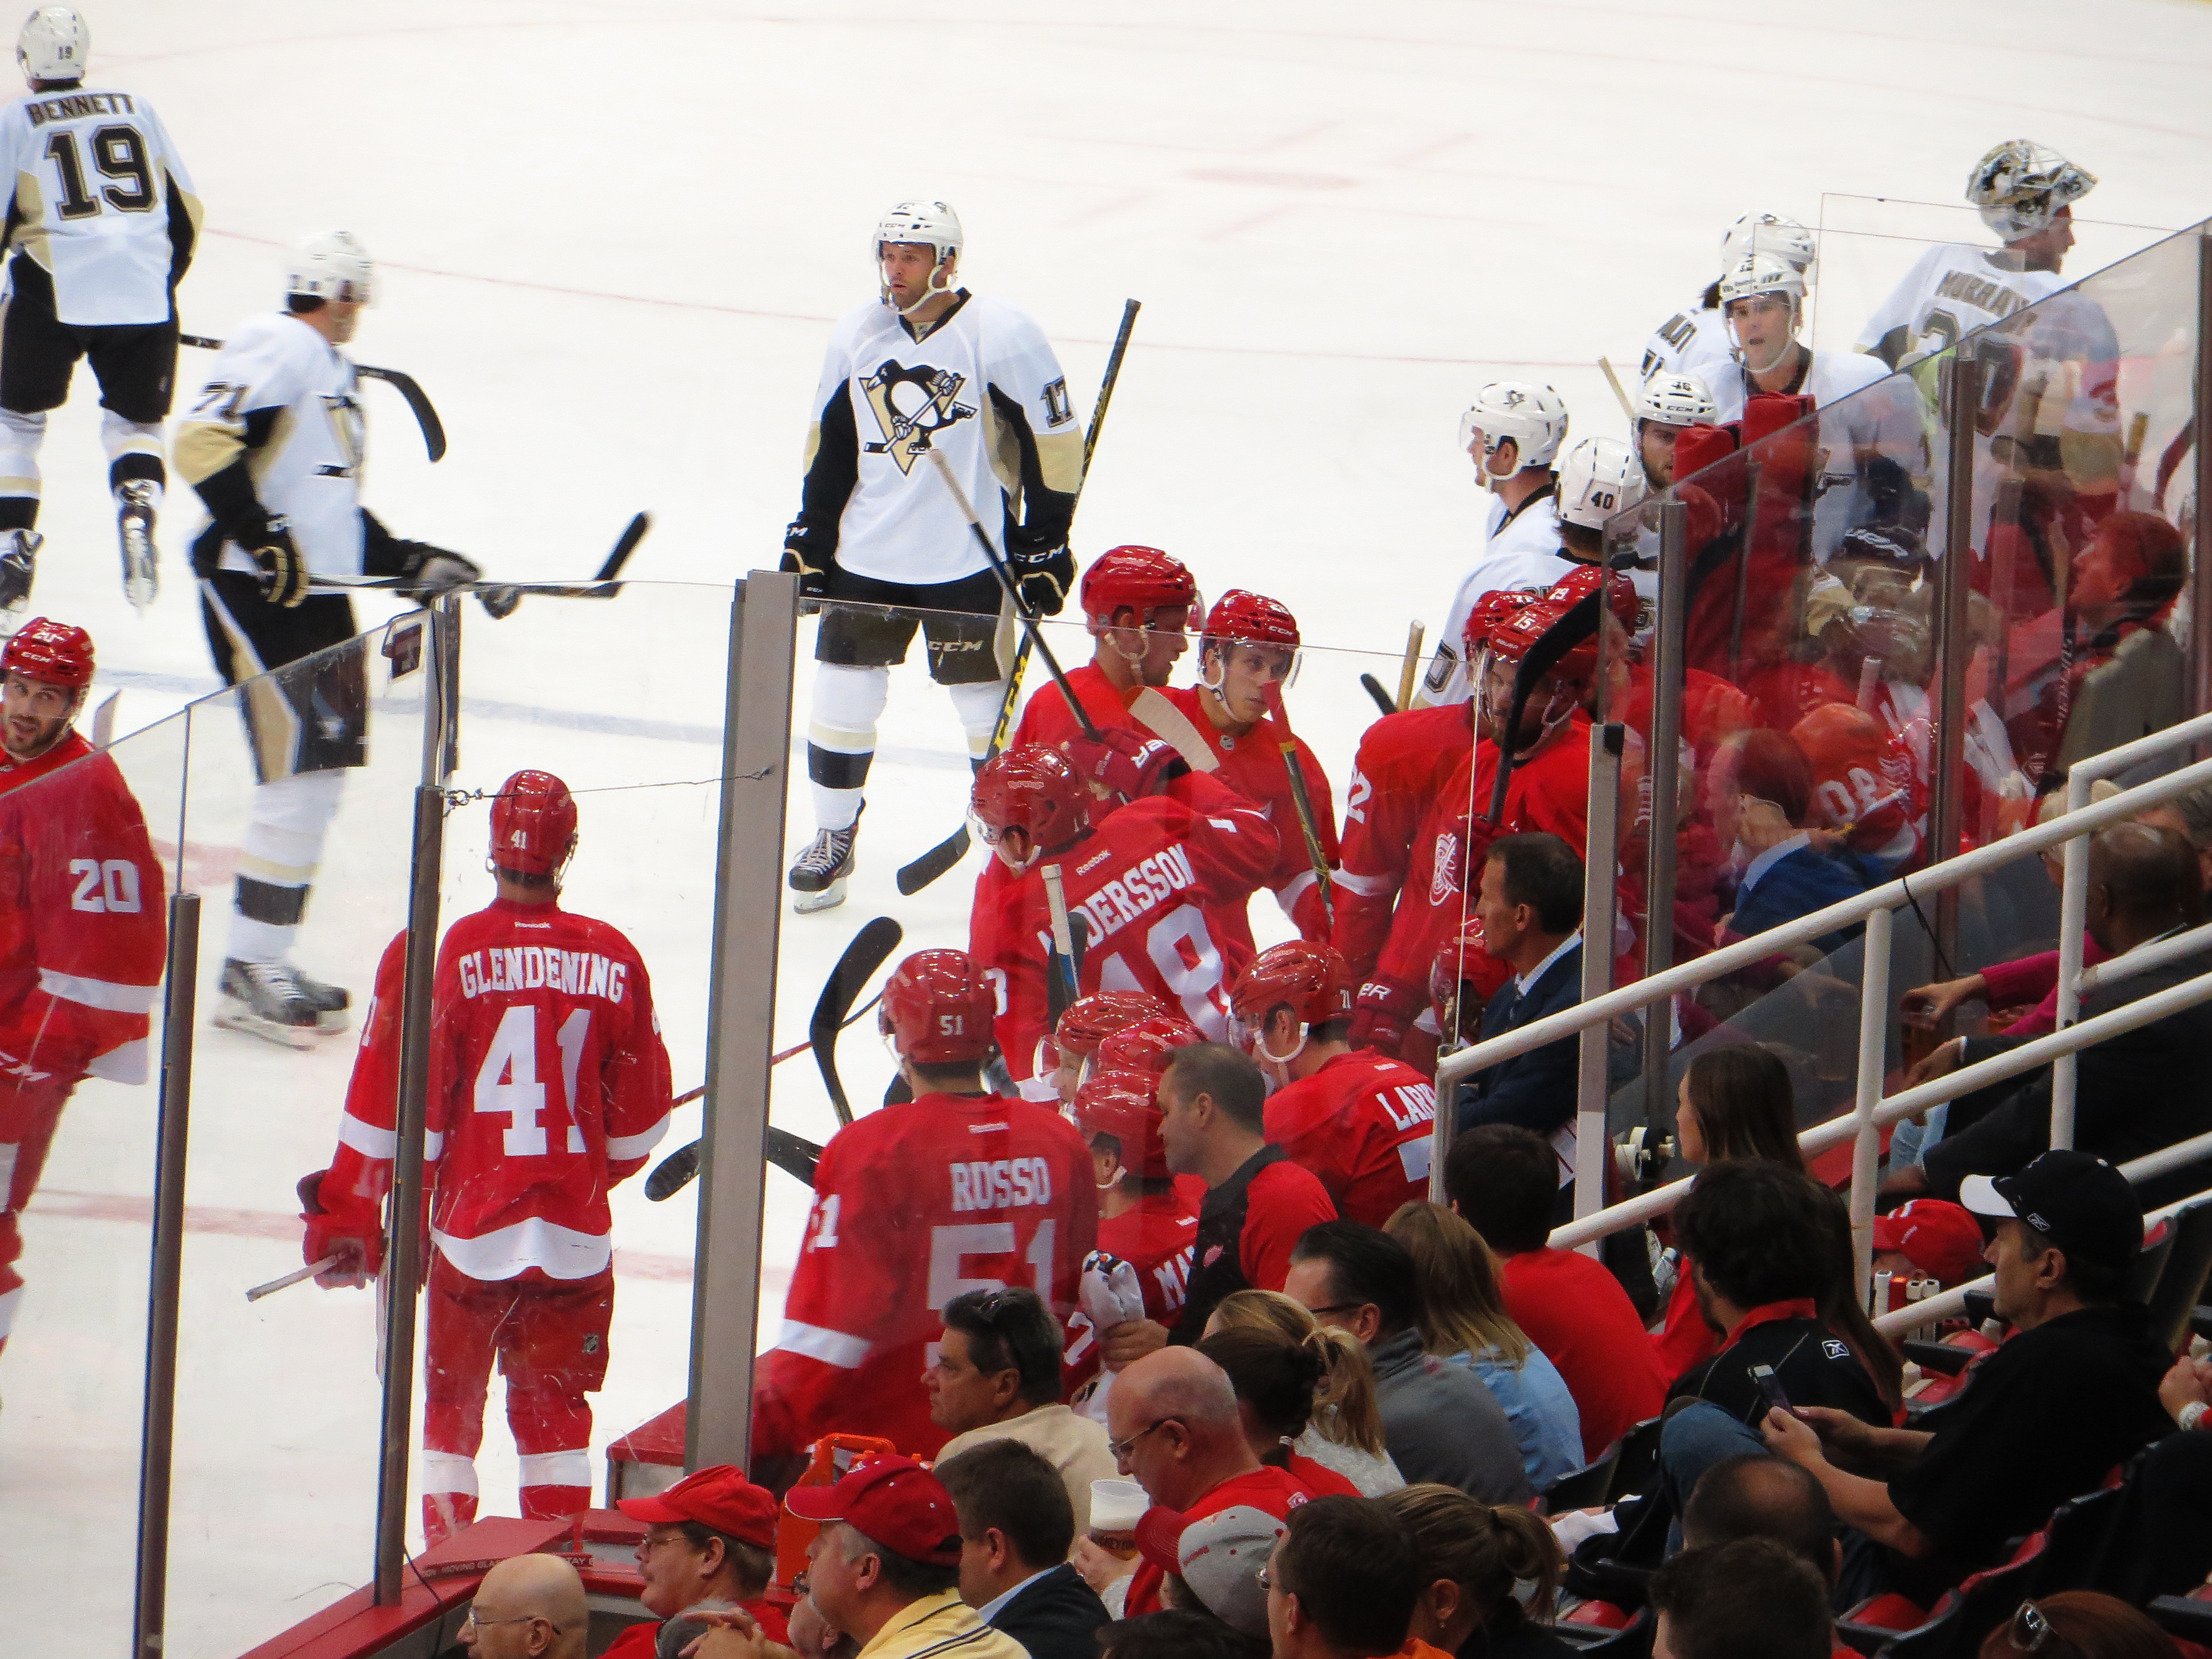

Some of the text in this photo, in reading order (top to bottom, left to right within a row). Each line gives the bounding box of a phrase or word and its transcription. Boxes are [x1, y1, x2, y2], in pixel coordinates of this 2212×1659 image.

[25, 93, 135, 128] BENNETT
[43, 123, 158, 221] 19
[1039, 375, 1074, 428] 17
[1591, 491, 1614, 509] 40
[928, 640, 984, 652] CCM
[1268, 625, 1293, 636] CCM
[510, 830, 528, 850] 41
[1076, 850, 1112, 877] Reebok
[69, 858, 142, 913] 20
[458, 946, 627, 1004] GLENDENING
[940, 1015, 963, 1036] 51
[473, 1005, 592, 1157] 41
